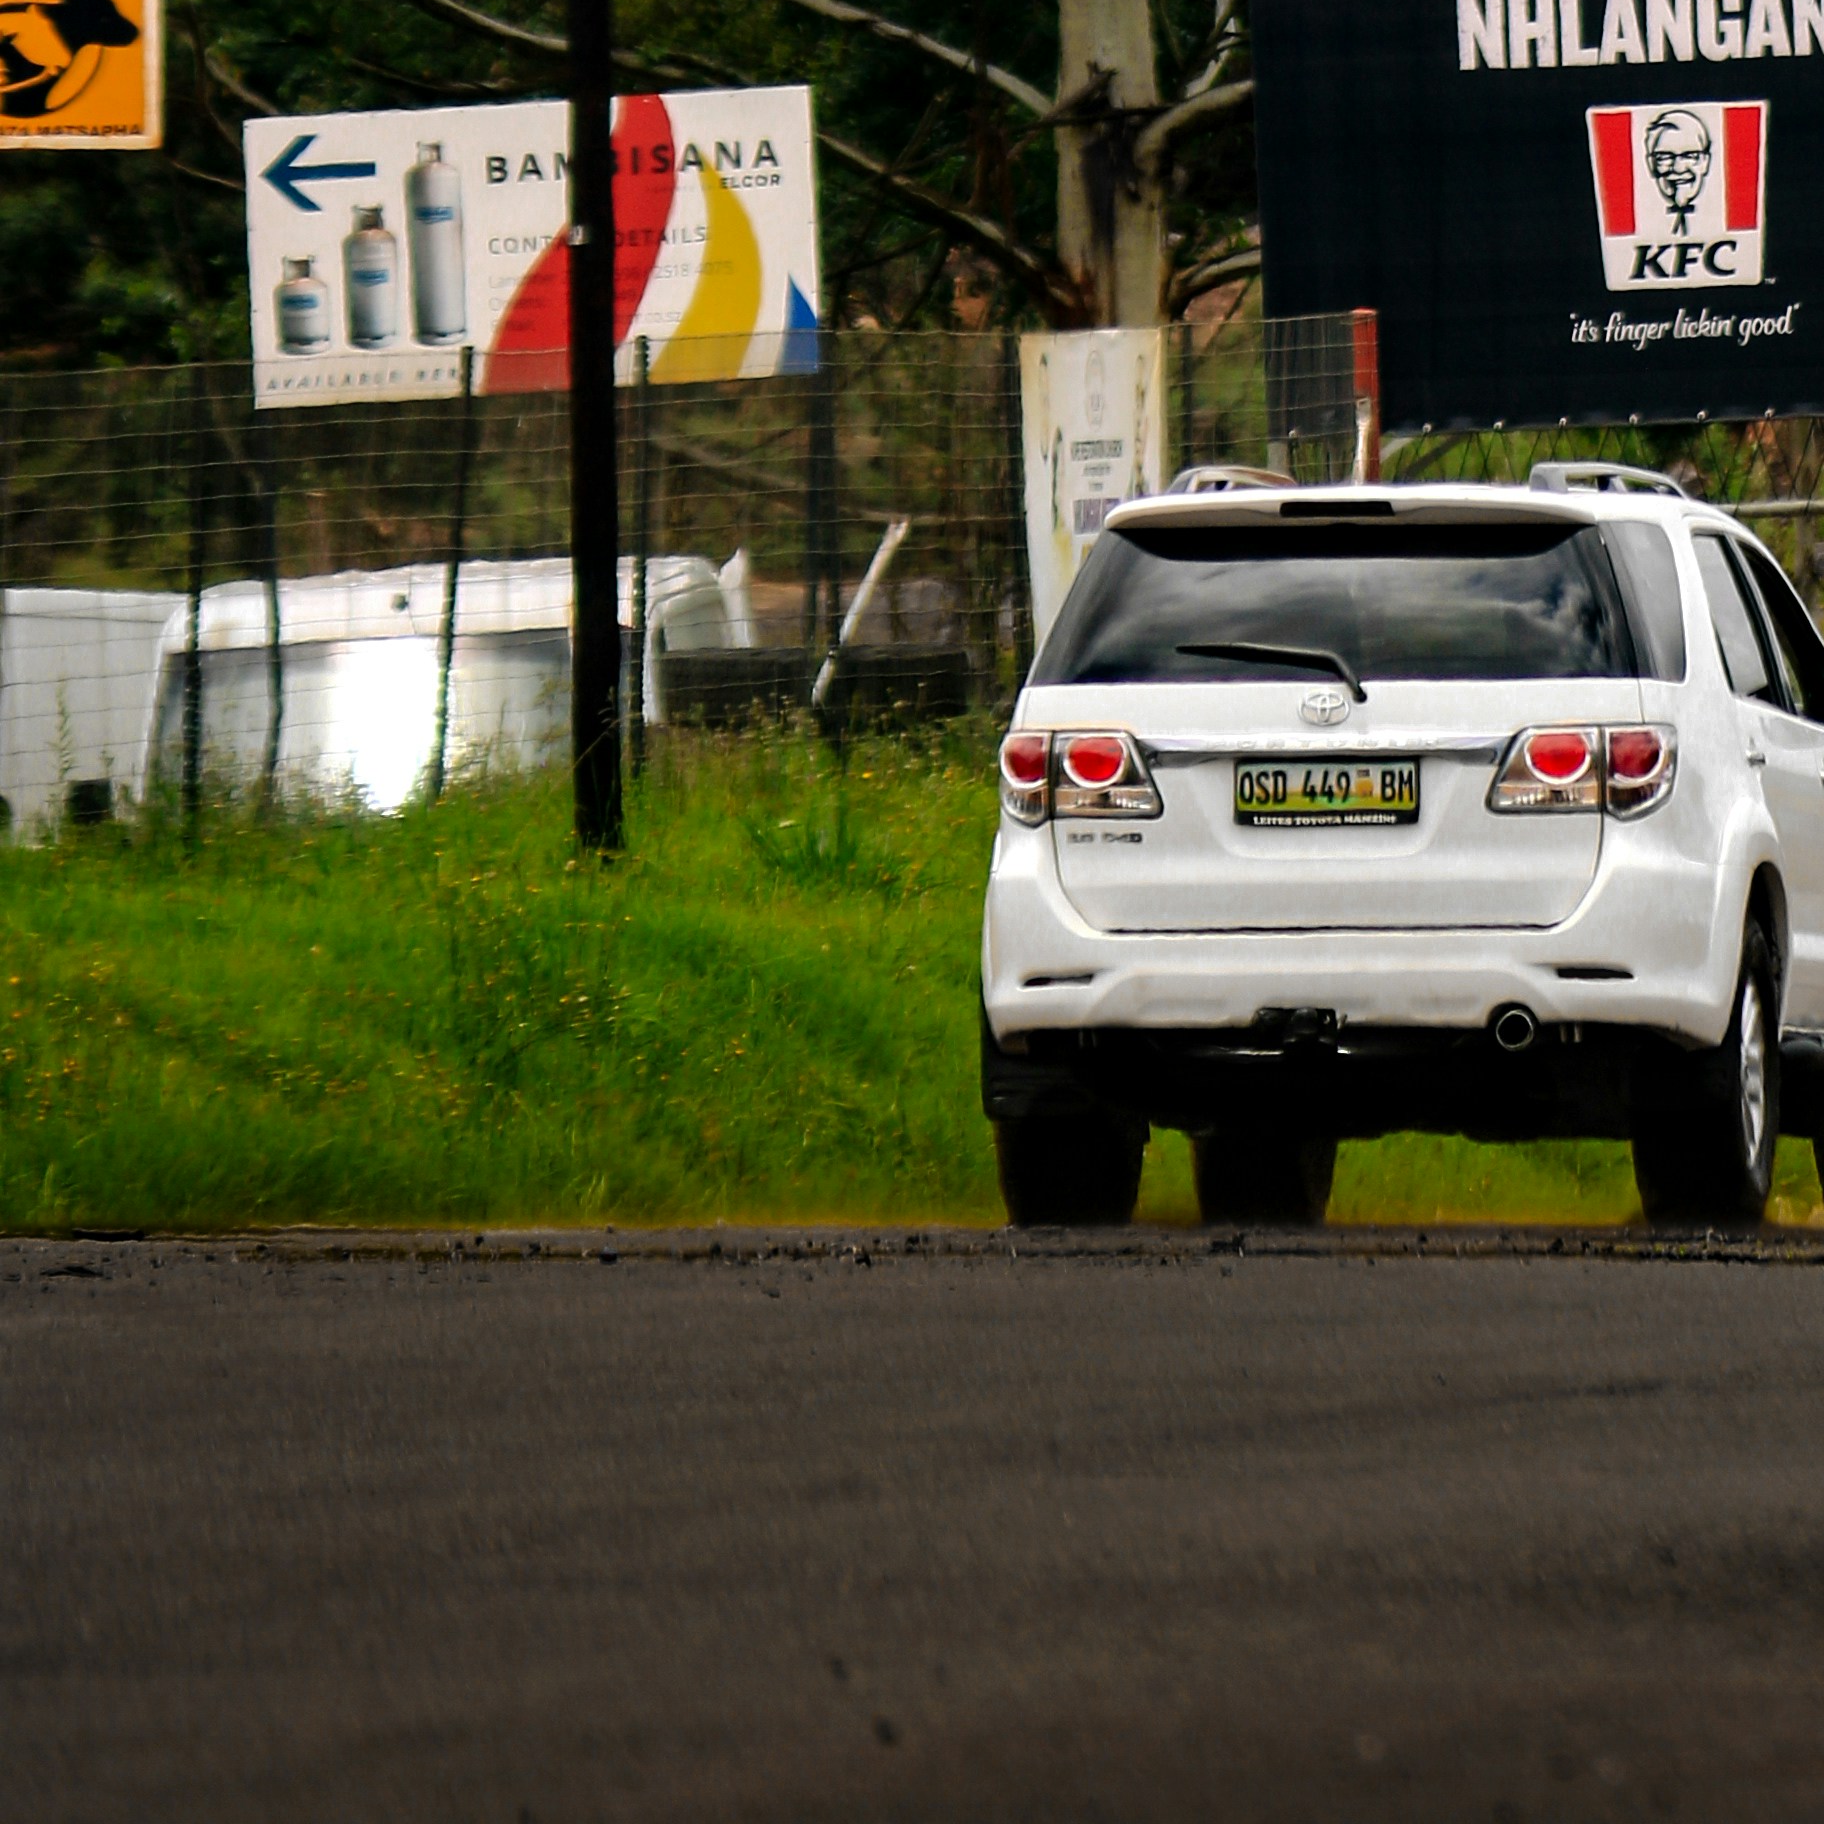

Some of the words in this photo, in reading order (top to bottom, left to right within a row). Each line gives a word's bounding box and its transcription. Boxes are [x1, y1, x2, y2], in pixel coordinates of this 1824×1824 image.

[719, 173, 781, 189] ELCOR
[1628, 240, 1738, 280] KFC
[1604, 311, 1672, 351] finger
[1239, 770, 1288, 806] OSD
[1302, 769, 1351, 804] 449
[1380, 769, 1415, 803] BM
[1294, 815, 1342, 826] TOYOTA
